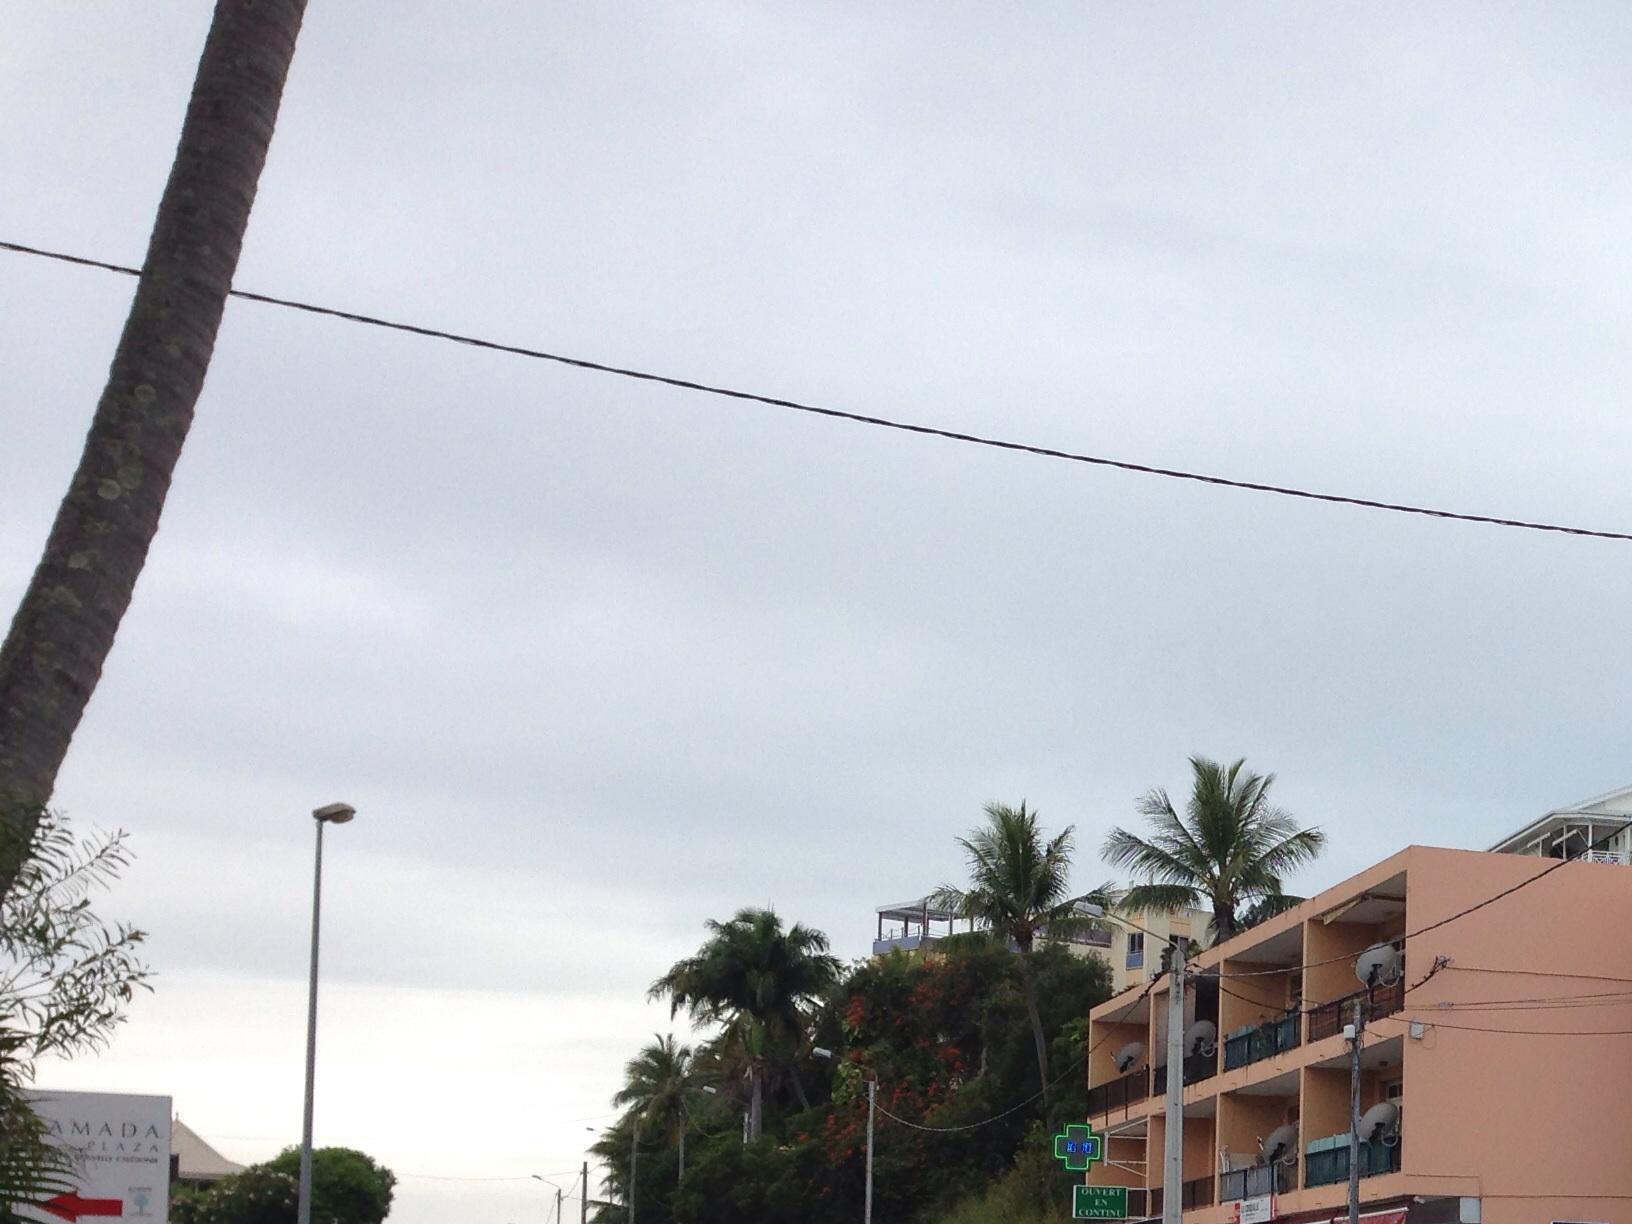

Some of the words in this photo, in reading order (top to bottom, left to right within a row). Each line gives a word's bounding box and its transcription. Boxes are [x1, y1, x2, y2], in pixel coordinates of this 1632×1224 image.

[49, 1119, 159, 1138] AMADA
[1081, 1188, 1121, 1196] OUVERT
[1079, 1208, 1121, 1217] CONTINU
